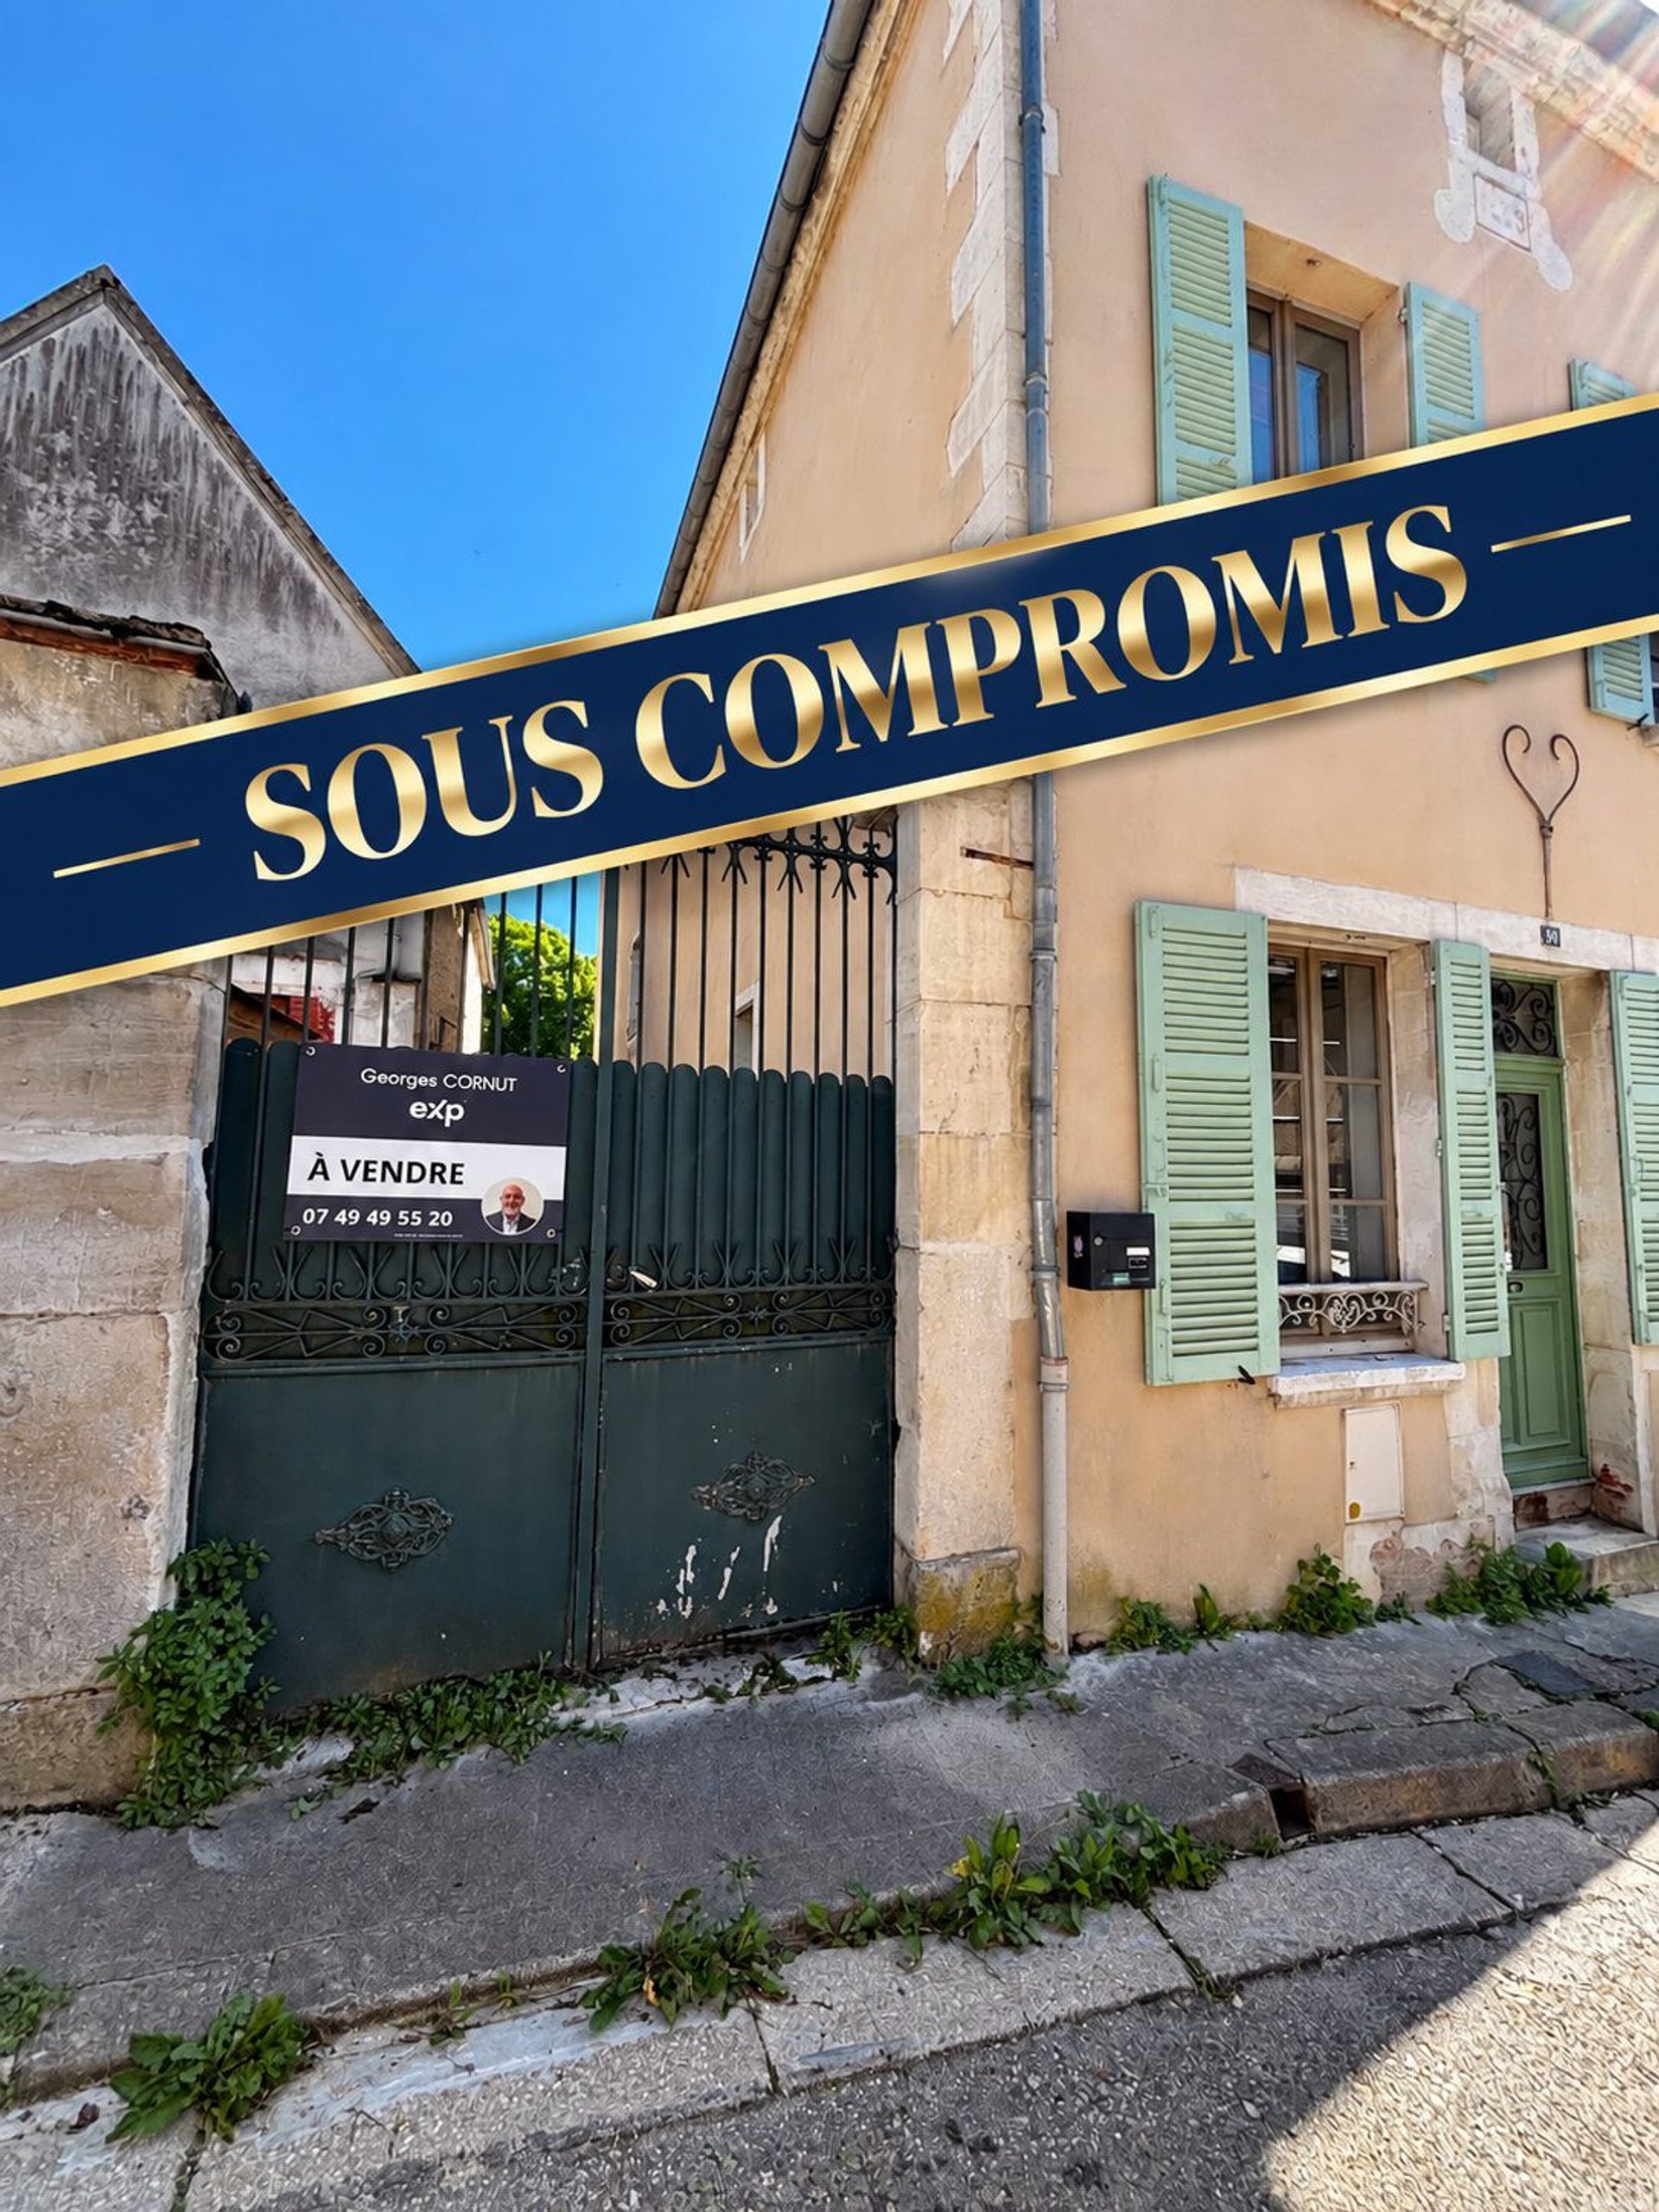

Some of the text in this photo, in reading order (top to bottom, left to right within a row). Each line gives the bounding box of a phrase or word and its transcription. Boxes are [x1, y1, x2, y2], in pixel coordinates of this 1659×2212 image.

[360, 1068, 518, 1092] Georges CORNUT
[410, 1099, 465, 1127] exp
[307, 1152, 465, 1185] À VENDRE
[302, 1208, 454, 1227] 07 49 49 55 20
